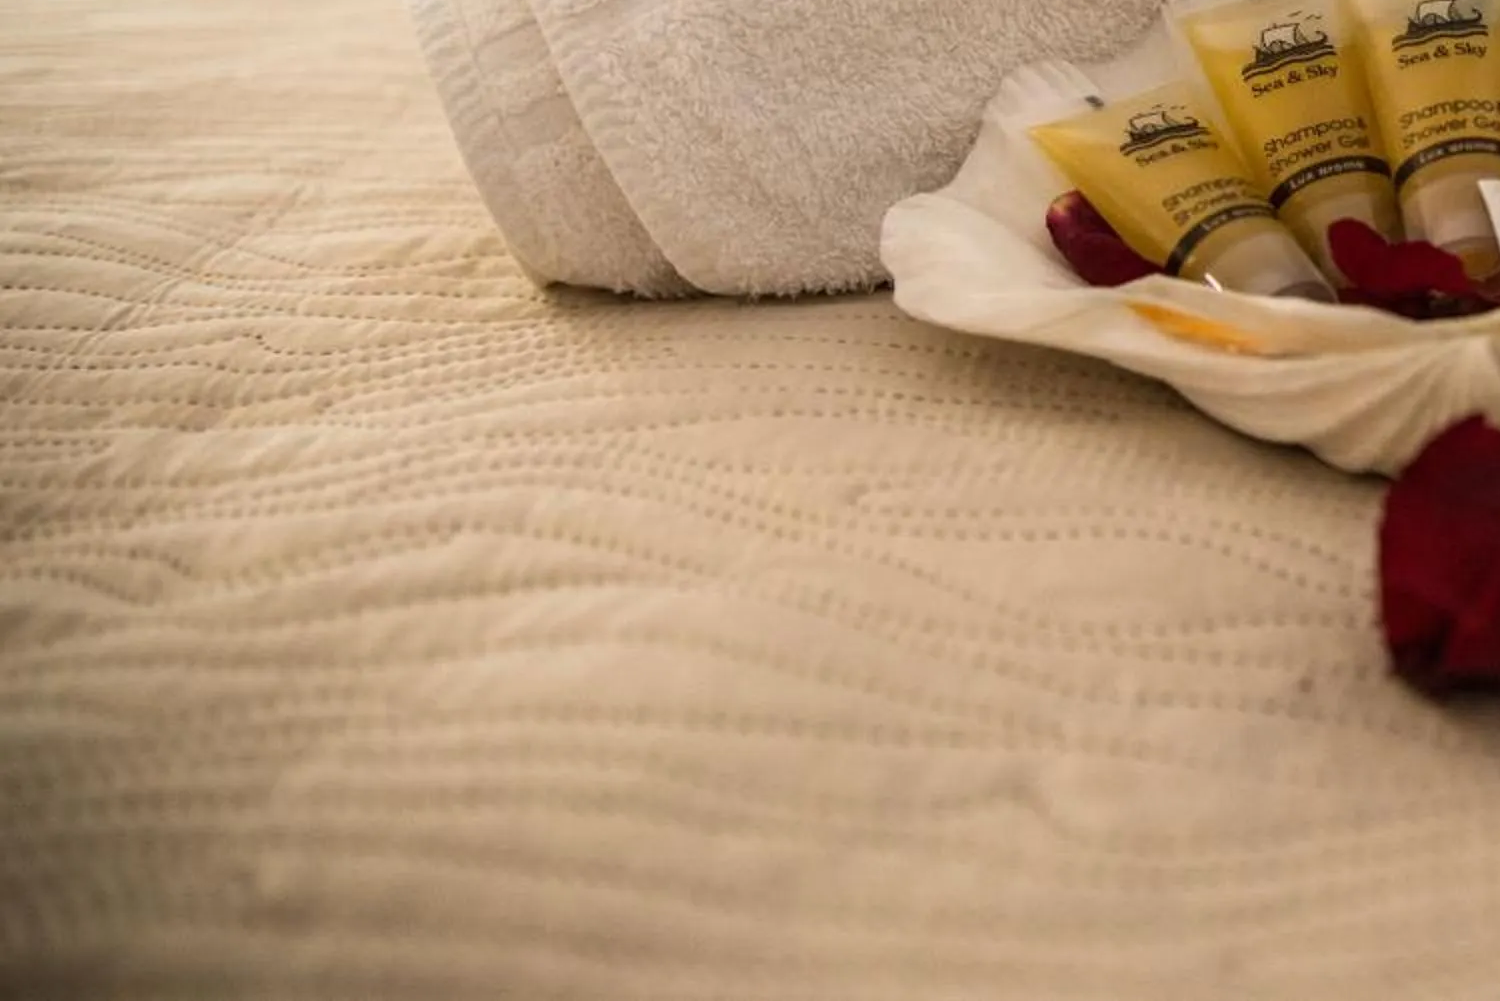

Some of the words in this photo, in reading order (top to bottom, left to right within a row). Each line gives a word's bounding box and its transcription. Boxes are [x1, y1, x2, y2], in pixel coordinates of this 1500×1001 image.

[1397, 51, 1430, 70] Sea
[1433, 44, 1449, 59] &
[1454, 42, 1488, 59] Sky
[1251, 80, 1285, 98] Sea
[1287, 70, 1302, 85] &
[1305, 64, 1339, 80] Sky
